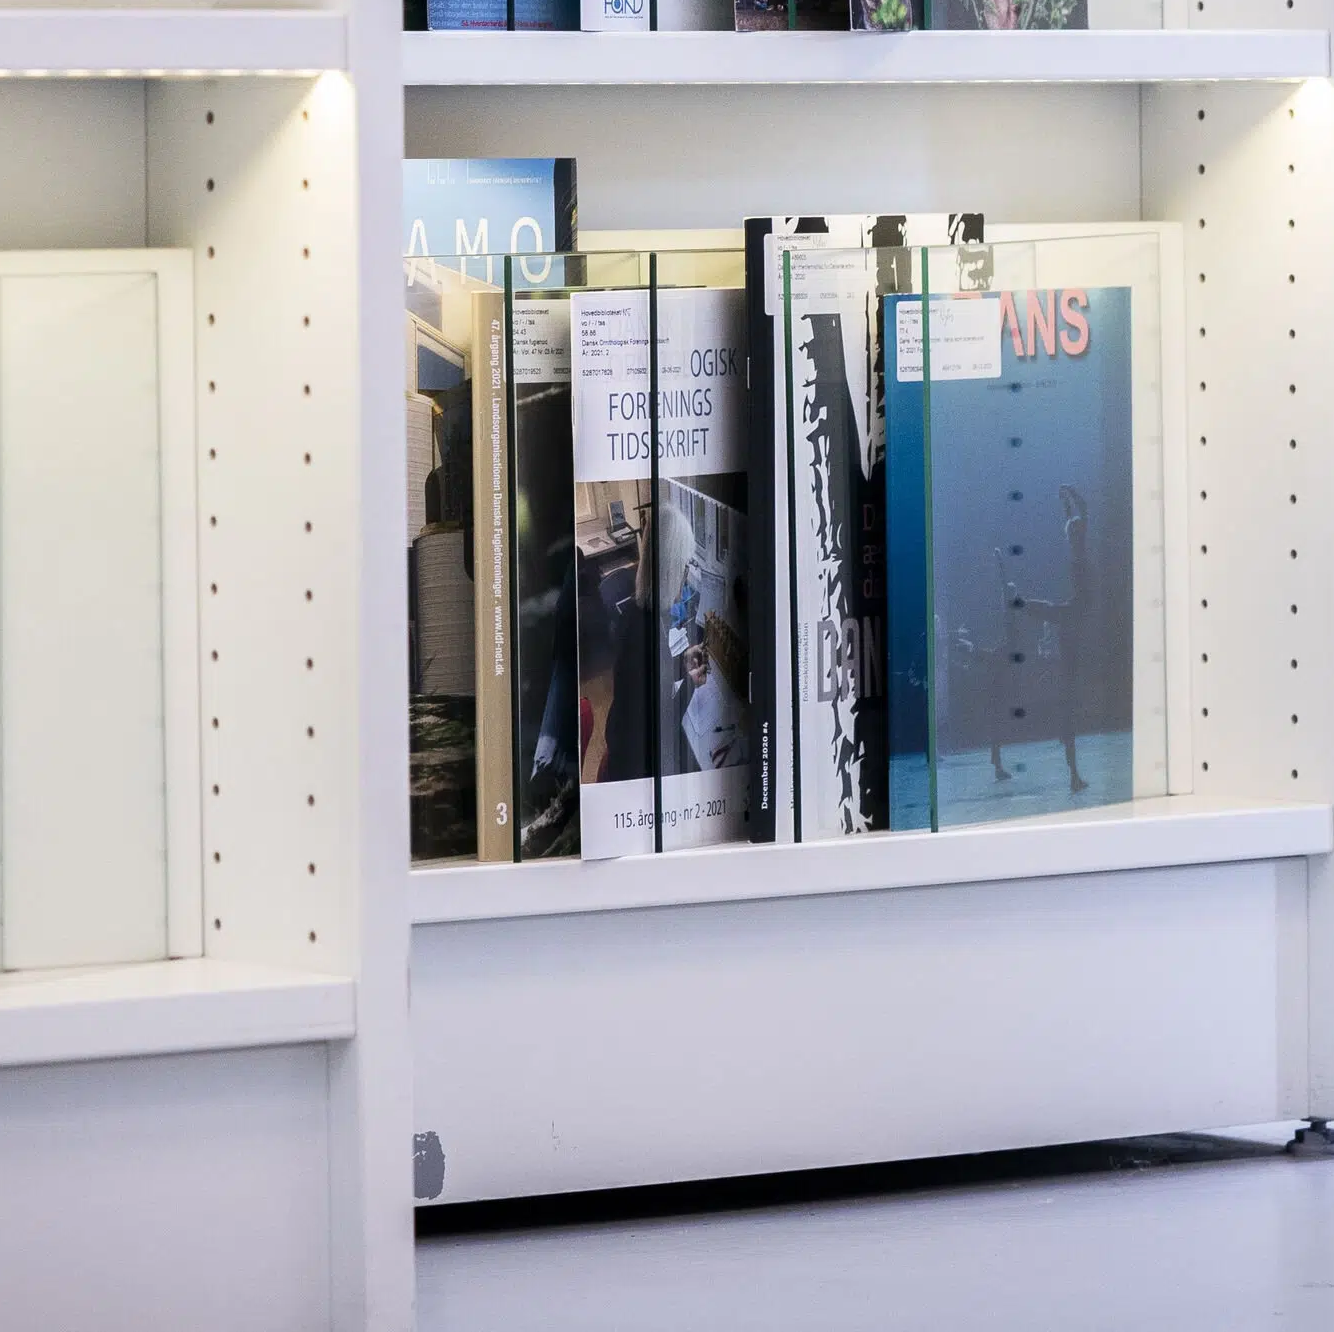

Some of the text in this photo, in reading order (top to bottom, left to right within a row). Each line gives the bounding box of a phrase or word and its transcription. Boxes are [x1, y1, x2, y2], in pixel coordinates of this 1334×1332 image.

[491, 319, 499, 332] 47.
[953, 288, 1090, 357] ANS
[490, 335, 499, 367] årgang
[690, 347, 738, 378] OGISK
[492, 368, 501, 390] 2021
[609, 388, 712, 421] FORENINGS
[491, 399, 502, 499] Landsorganisationen
[606, 428, 710, 461] TIDSSKRIFT
[492, 501, 502, 526] Danske
[492, 529, 504, 598] Fugleforeninger
[494, 802, 509, 826] 3
[614, 812, 636, 829] 115.
[684, 807, 694, 821] nr
[695, 804, 700, 819] 2
[707, 799, 727, 817] 2021
